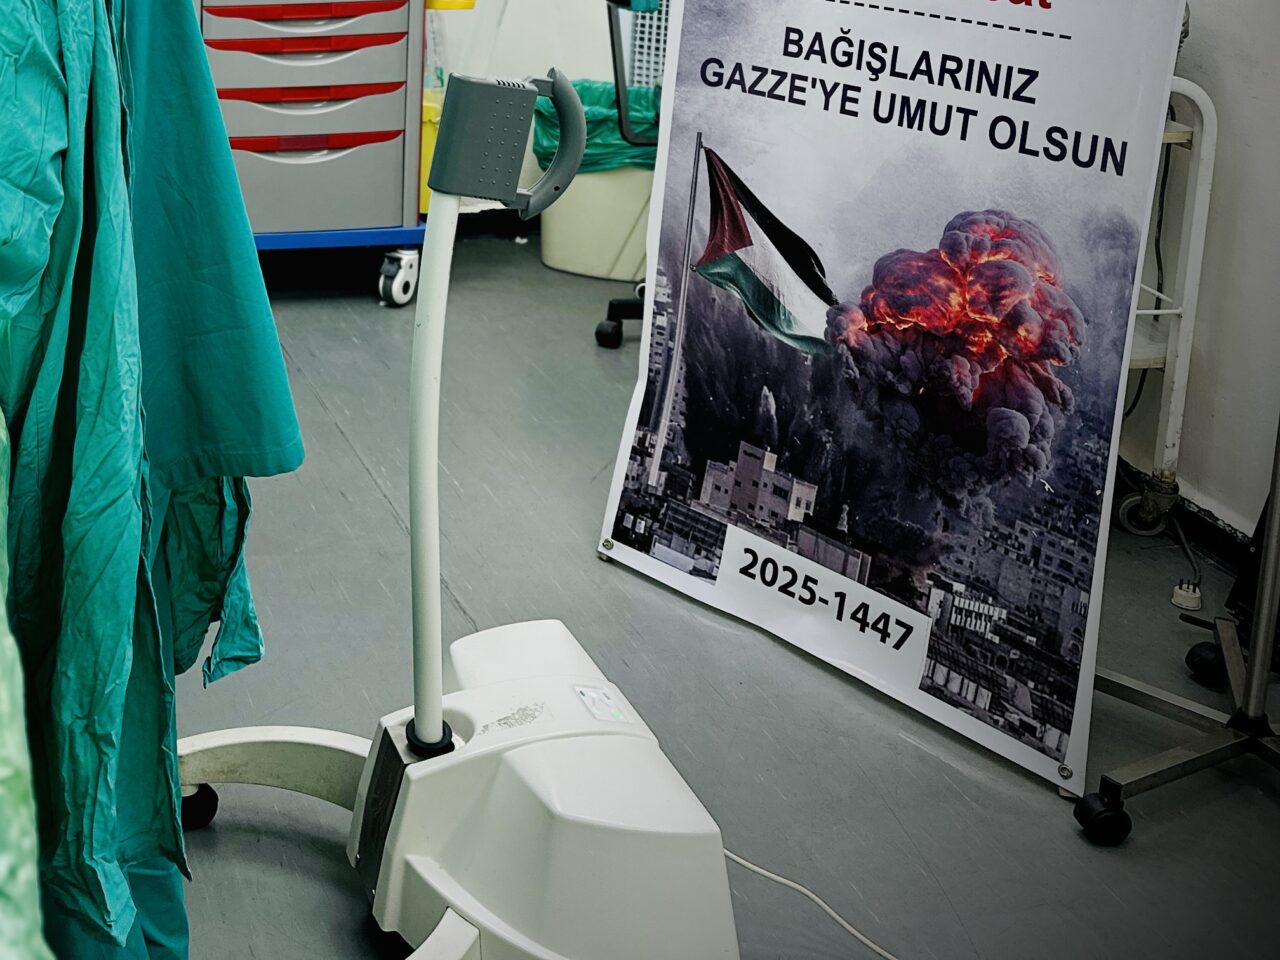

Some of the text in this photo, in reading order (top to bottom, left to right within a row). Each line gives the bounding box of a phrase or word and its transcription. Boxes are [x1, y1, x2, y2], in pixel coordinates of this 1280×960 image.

[699, 57, 1129, 177] GAZZE'YE UMUT OLSUN
[782, 26, 1040, 105] BAĞIŞLARINIZ
[738, 547, 914, 651] 2025-1447
